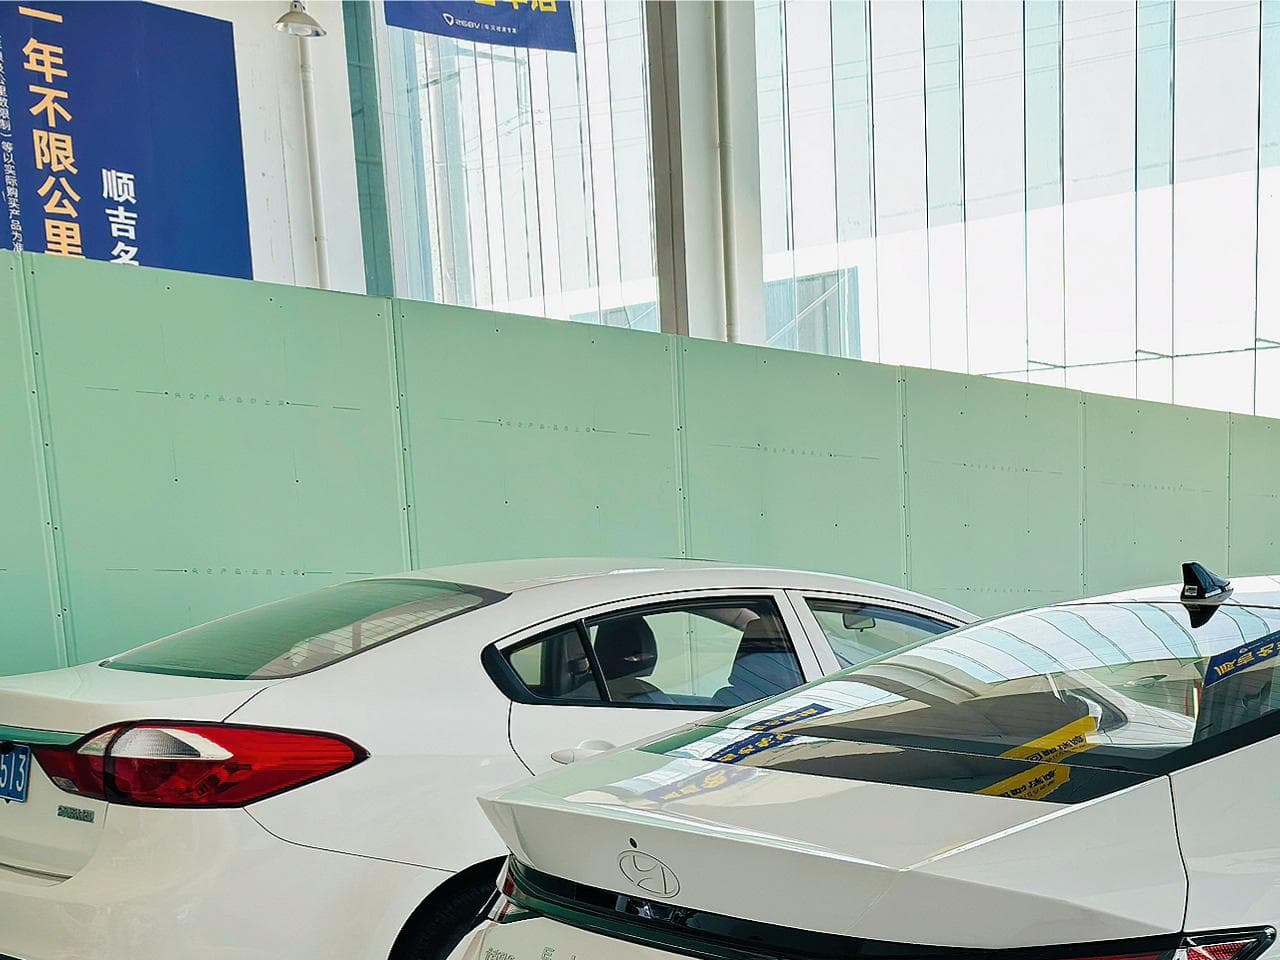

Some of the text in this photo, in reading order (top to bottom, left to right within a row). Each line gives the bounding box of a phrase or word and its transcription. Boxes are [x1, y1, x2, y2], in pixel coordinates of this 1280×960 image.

[18, 6, 85, 260] 一年不限公里
